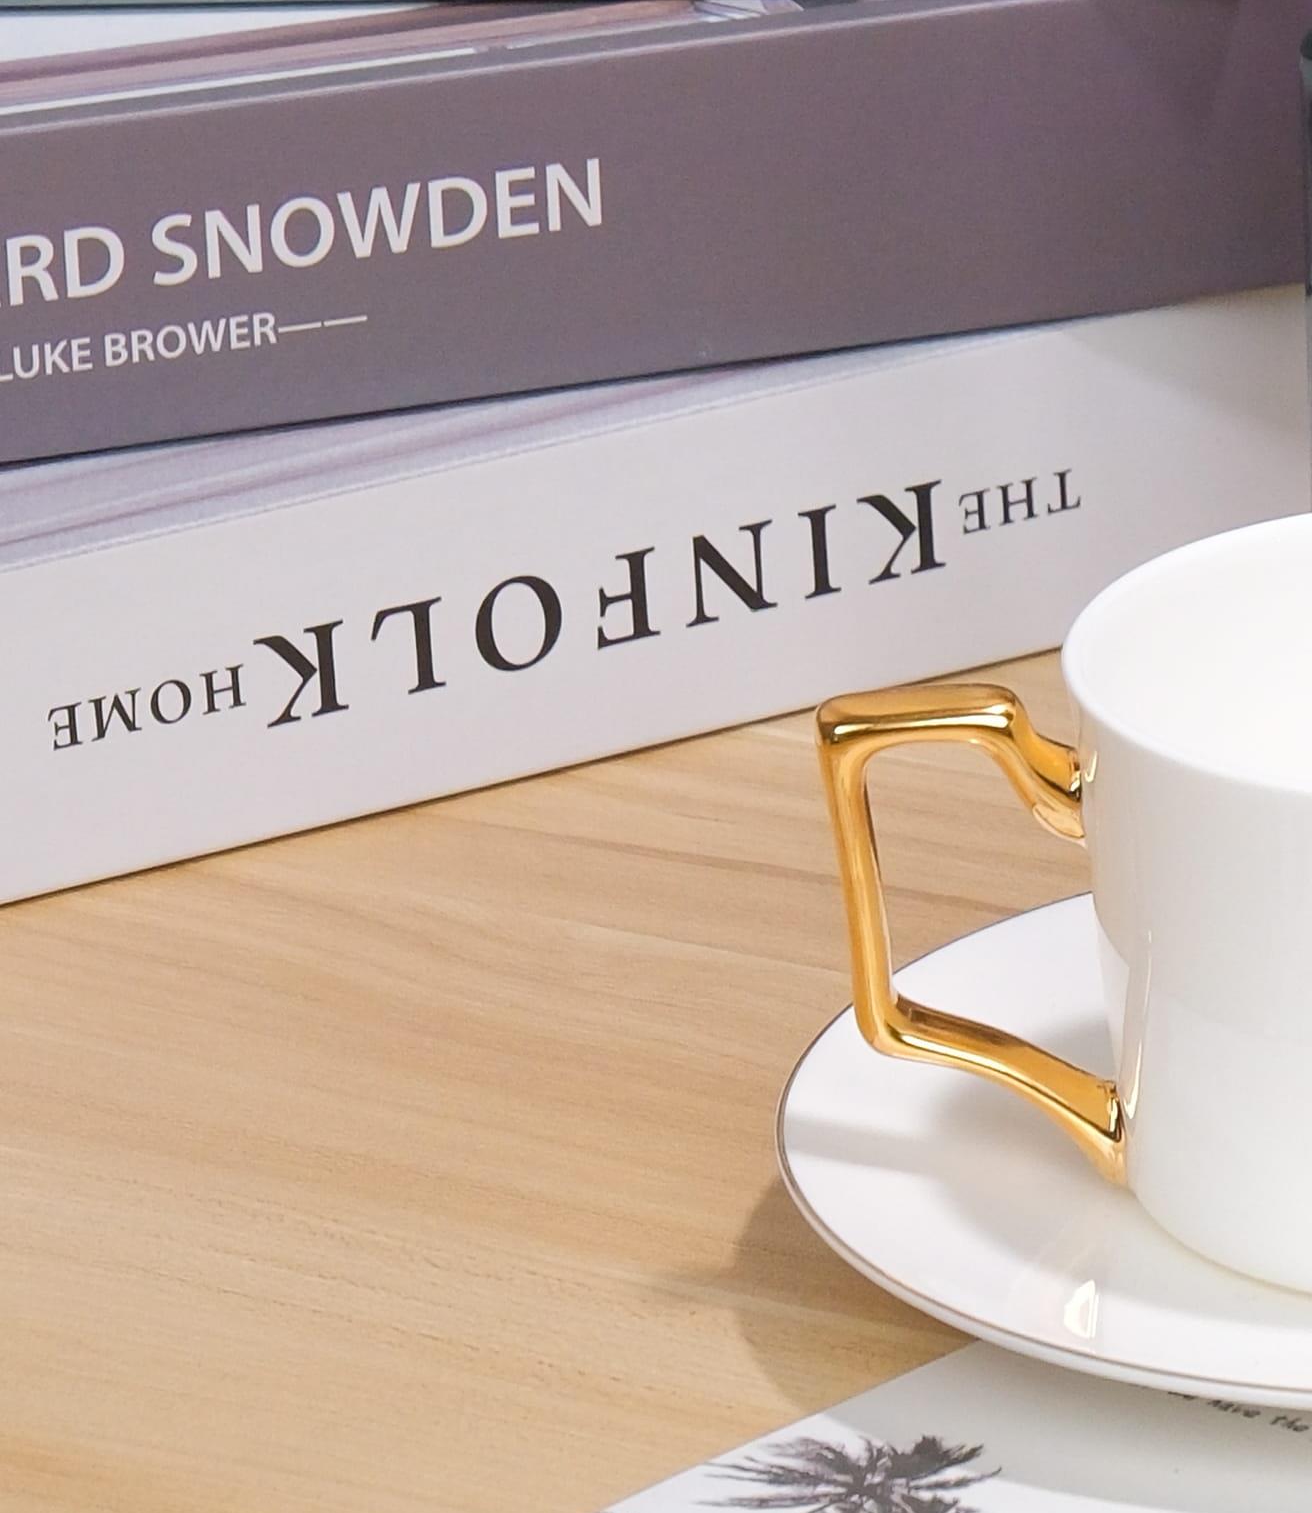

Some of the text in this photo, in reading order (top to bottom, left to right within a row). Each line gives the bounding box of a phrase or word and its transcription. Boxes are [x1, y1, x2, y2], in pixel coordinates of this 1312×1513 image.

[0, 158, 602, 307] RD SNOWDEN
[47, 470, 1082, 751] THE KINFOLK HOME
[1270, 1415, 1310, 1433] the
